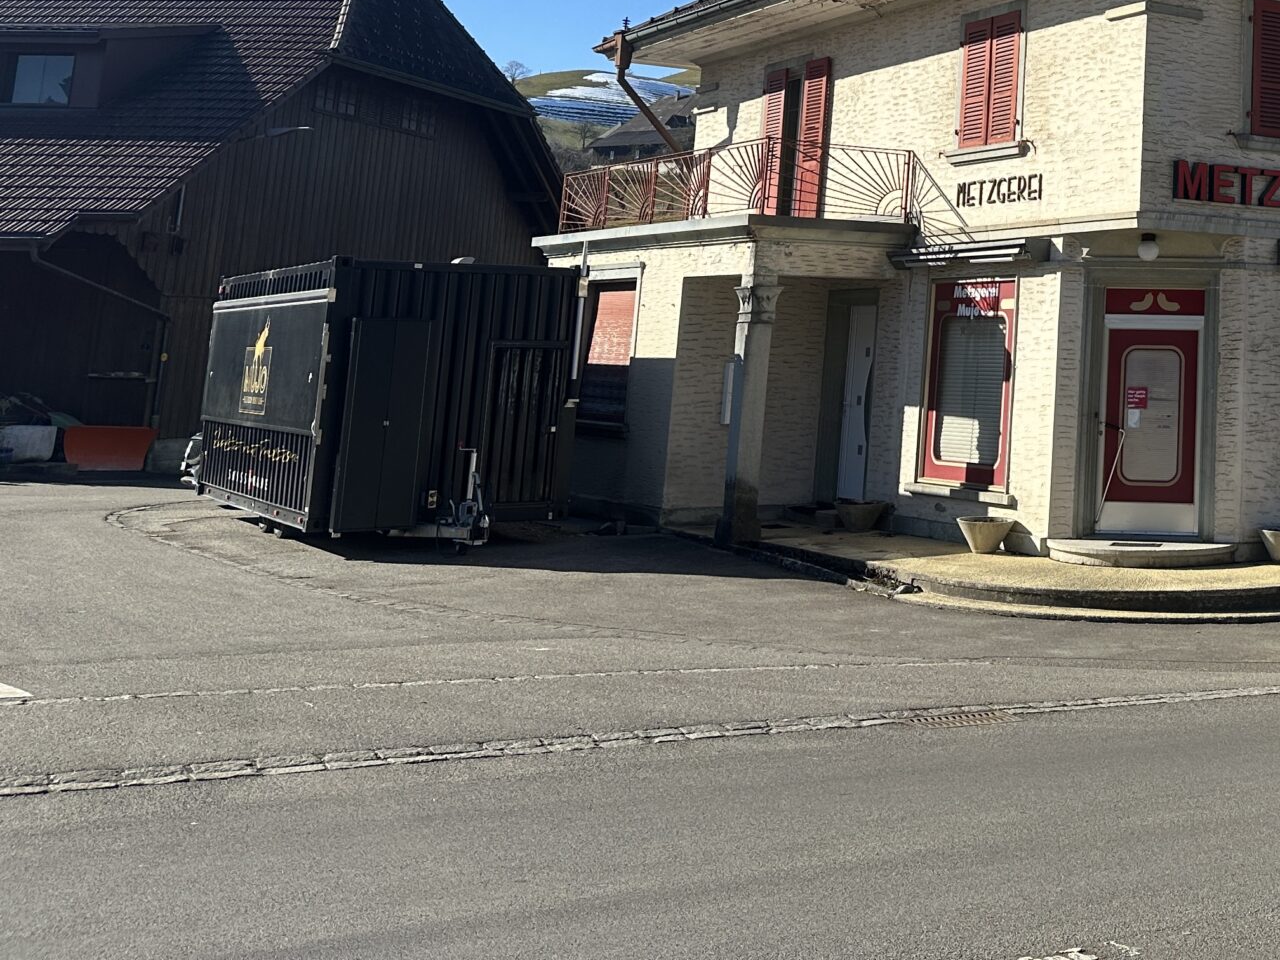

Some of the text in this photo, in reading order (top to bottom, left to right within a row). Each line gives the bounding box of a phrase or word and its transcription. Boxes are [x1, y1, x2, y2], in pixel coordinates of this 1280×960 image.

[956, 173, 1043, 208] METZGEREI
[953, 283, 999, 301] Metzgerei
[957, 303, 980, 319] Mujo
